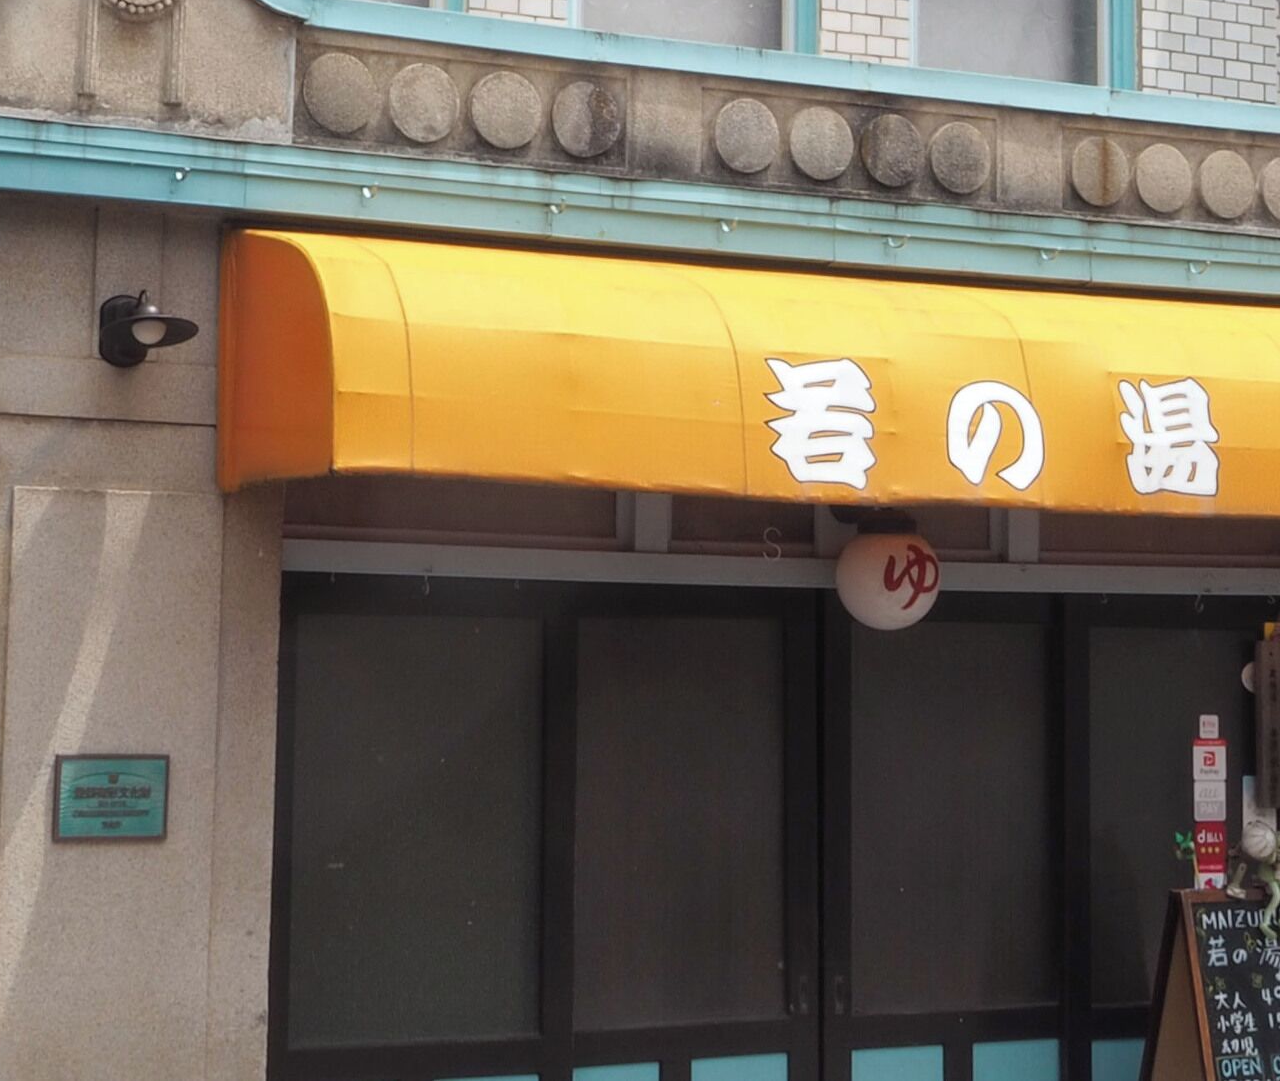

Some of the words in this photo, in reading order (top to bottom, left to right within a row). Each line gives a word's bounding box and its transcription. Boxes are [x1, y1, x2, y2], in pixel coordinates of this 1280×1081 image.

[763, 357, 1220, 497] 若の湯
[884, 543, 940, 610] ゆ
[1214, 991, 1247, 1010] 大人
[1217, 1011, 1258, 1034] 小学生
[1221, 1036, 1258, 1056] 幼児
[1221, 1057, 1263, 1077] OPEN
